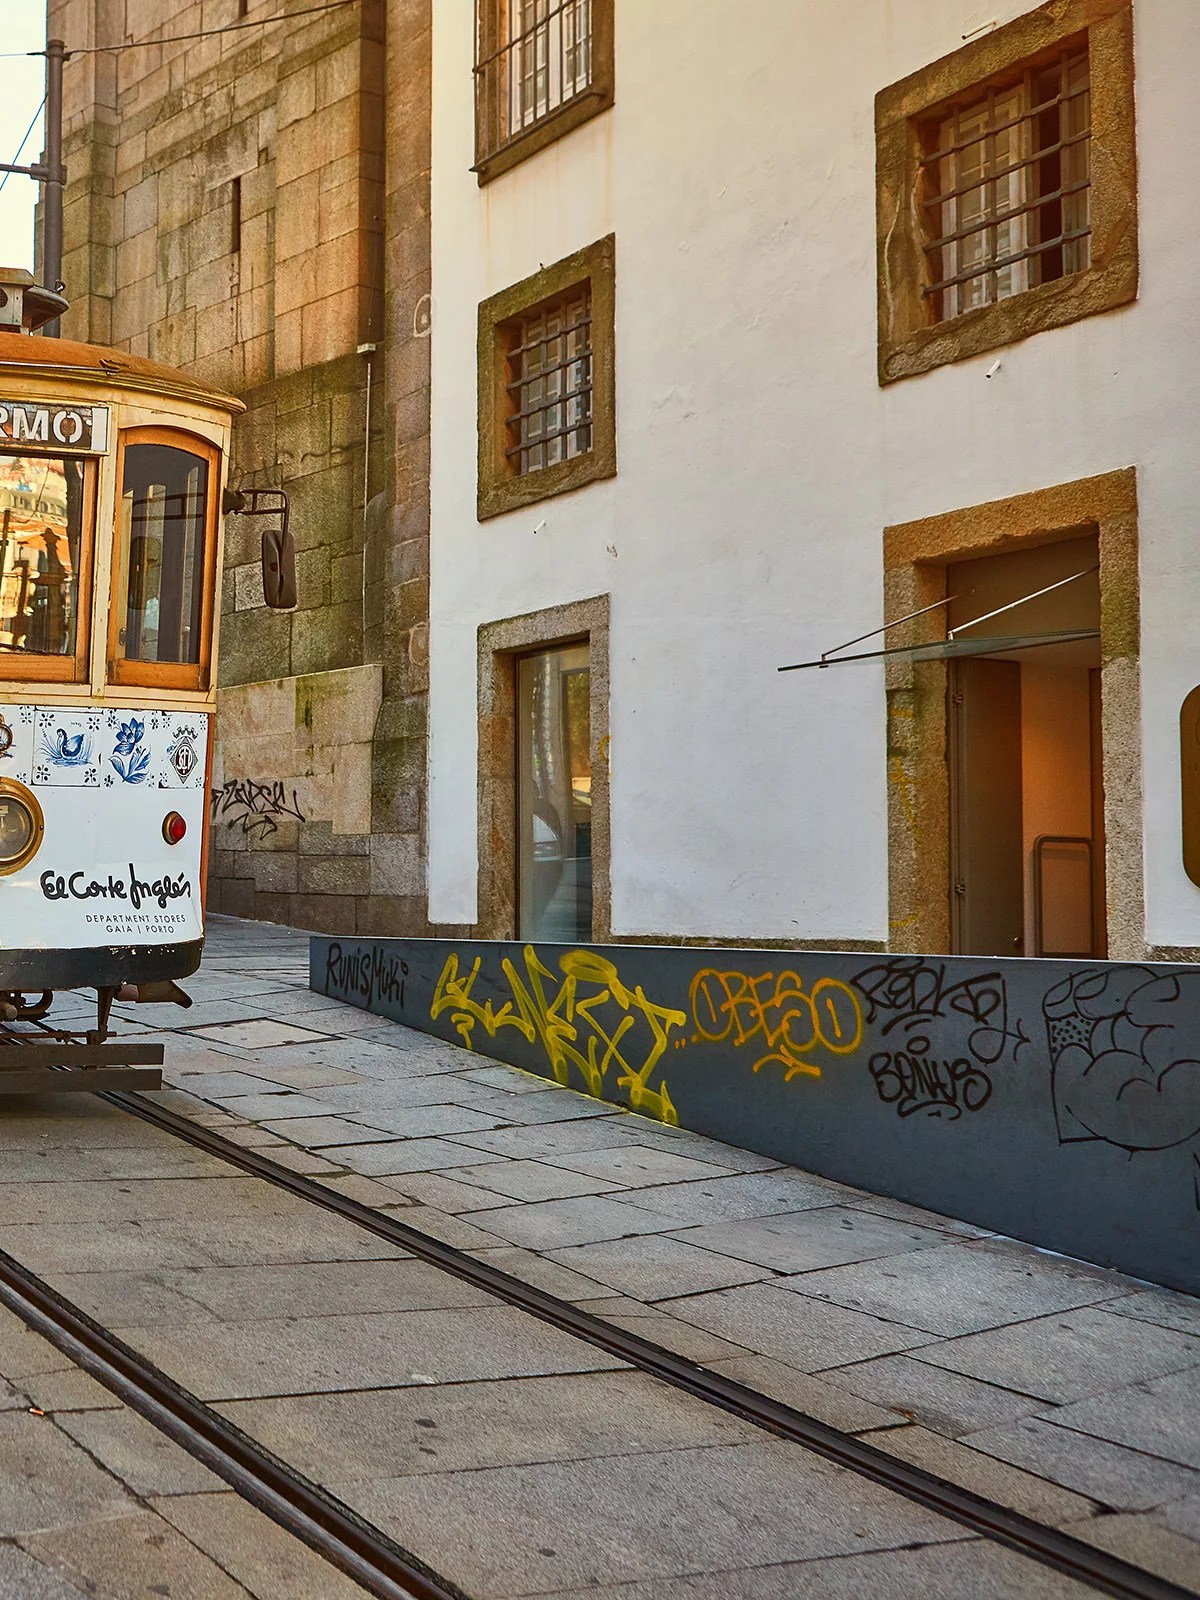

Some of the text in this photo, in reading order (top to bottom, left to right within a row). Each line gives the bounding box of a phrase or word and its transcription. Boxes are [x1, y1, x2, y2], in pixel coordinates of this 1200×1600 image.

[40, 870, 69, 901] El
[68, 871, 128, 900] Corte
[86, 914, 186, 924] DEPARTMENT STORES
[106, 924, 175, 934] GAIA PORTO
